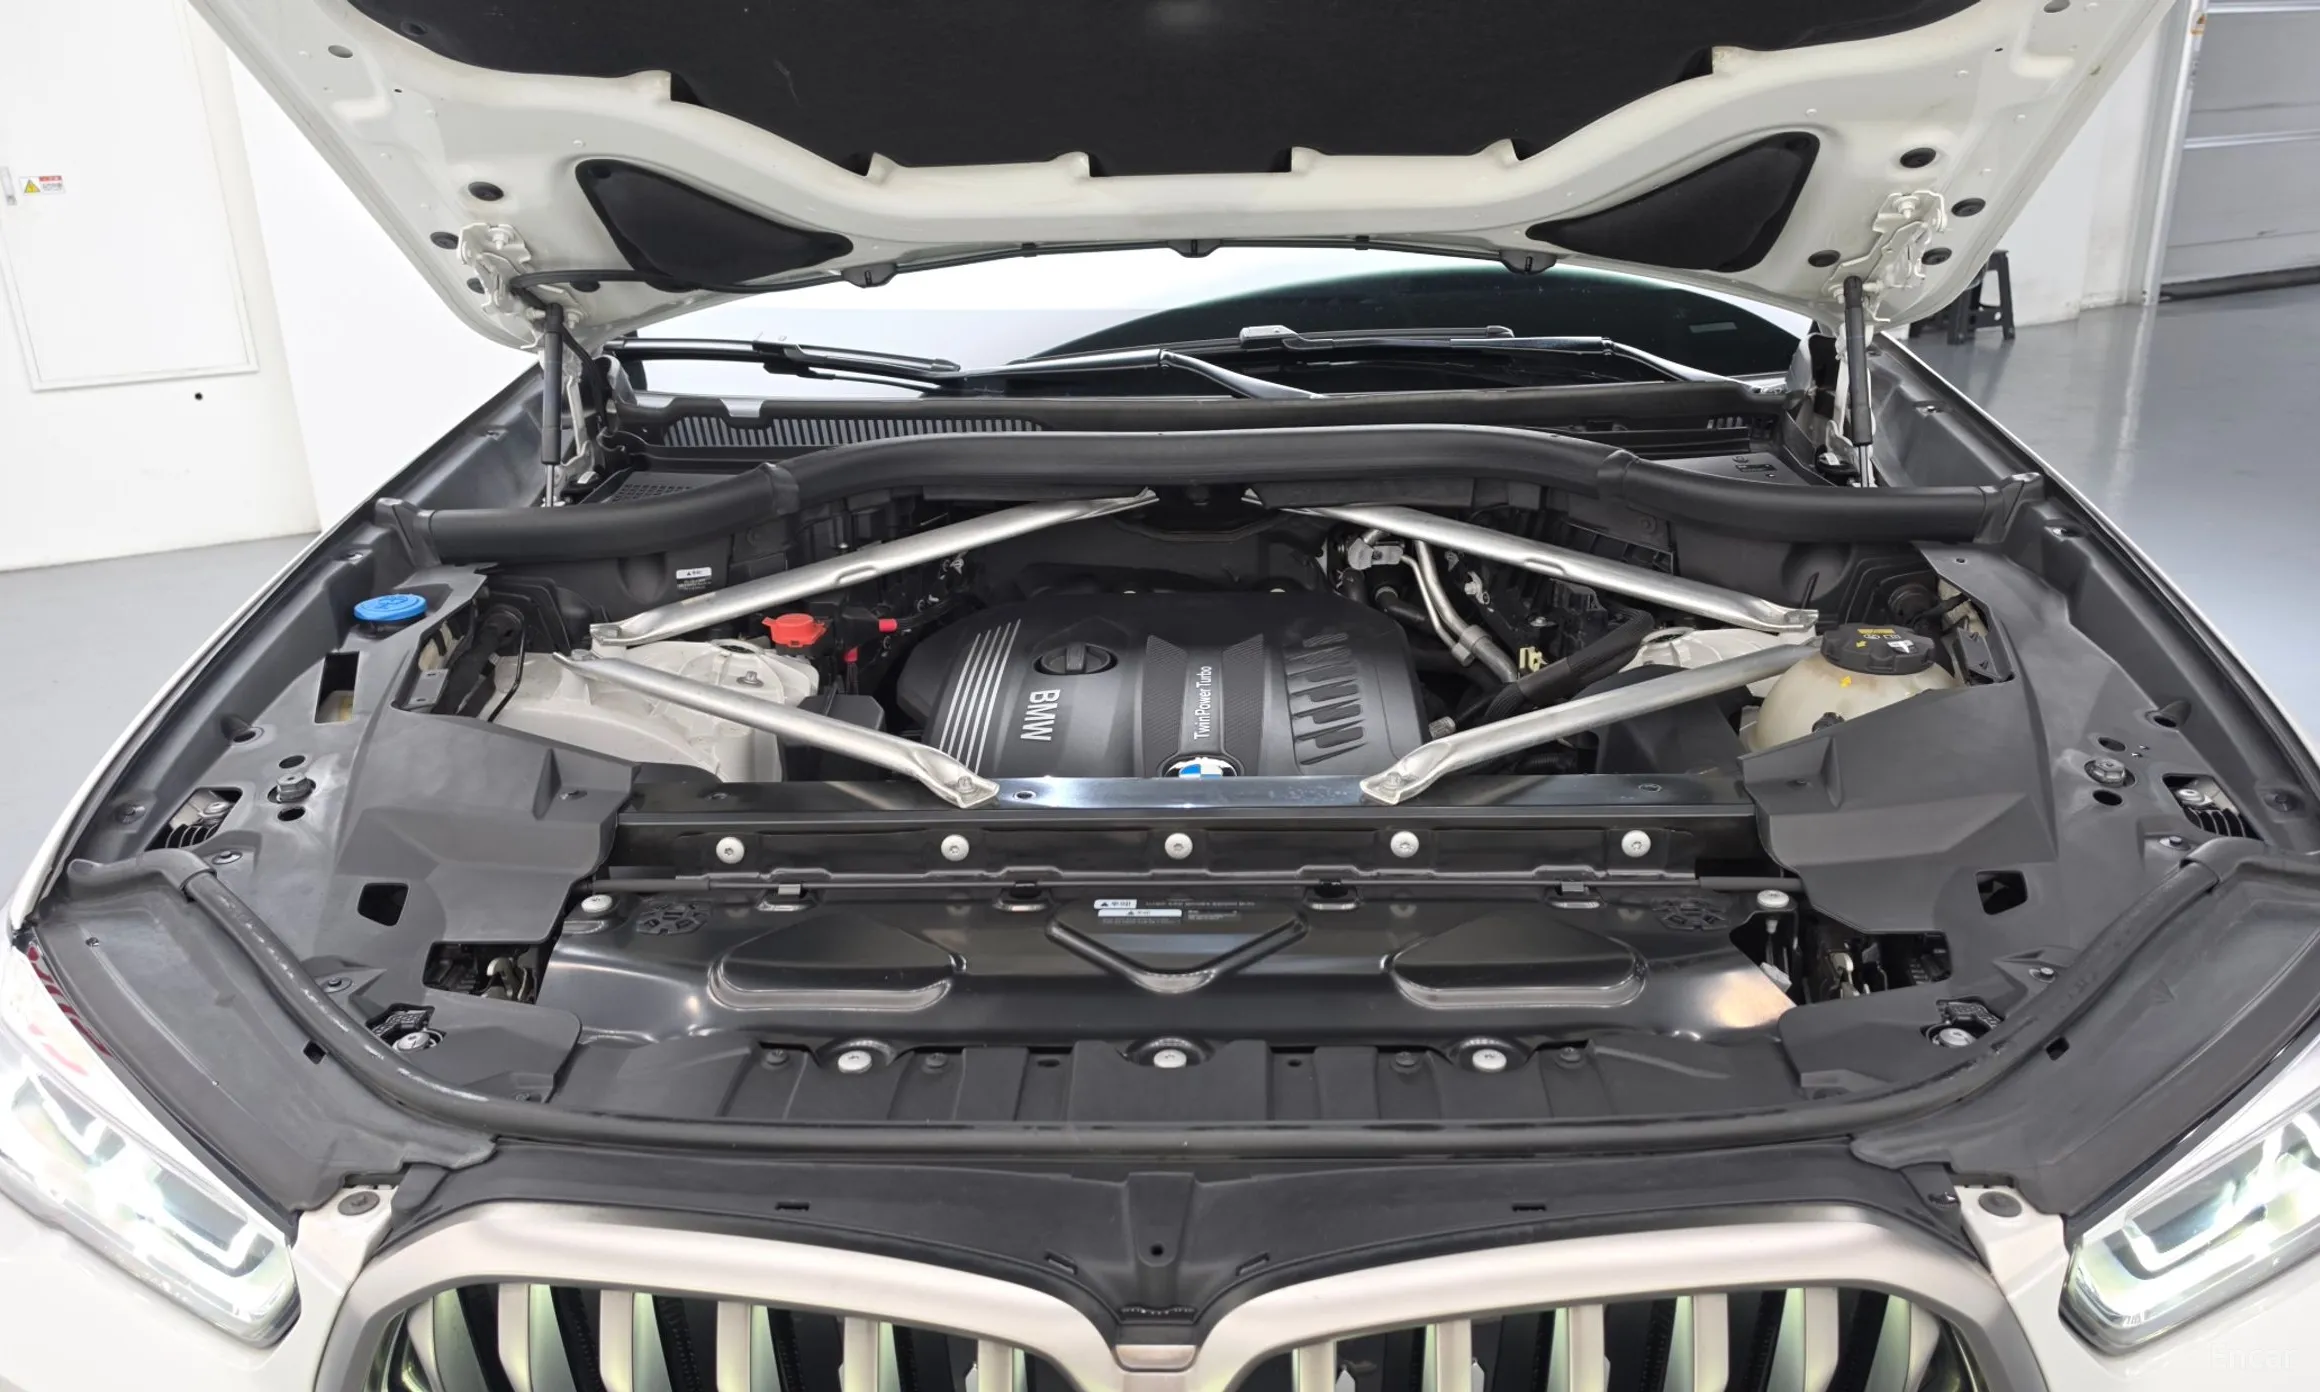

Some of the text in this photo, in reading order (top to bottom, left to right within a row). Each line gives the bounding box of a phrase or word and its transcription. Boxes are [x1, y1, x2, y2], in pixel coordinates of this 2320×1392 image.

[1020, 689, 1060, 741] BMW
[1193, 665, 1212, 740] TwinPower Turbo
